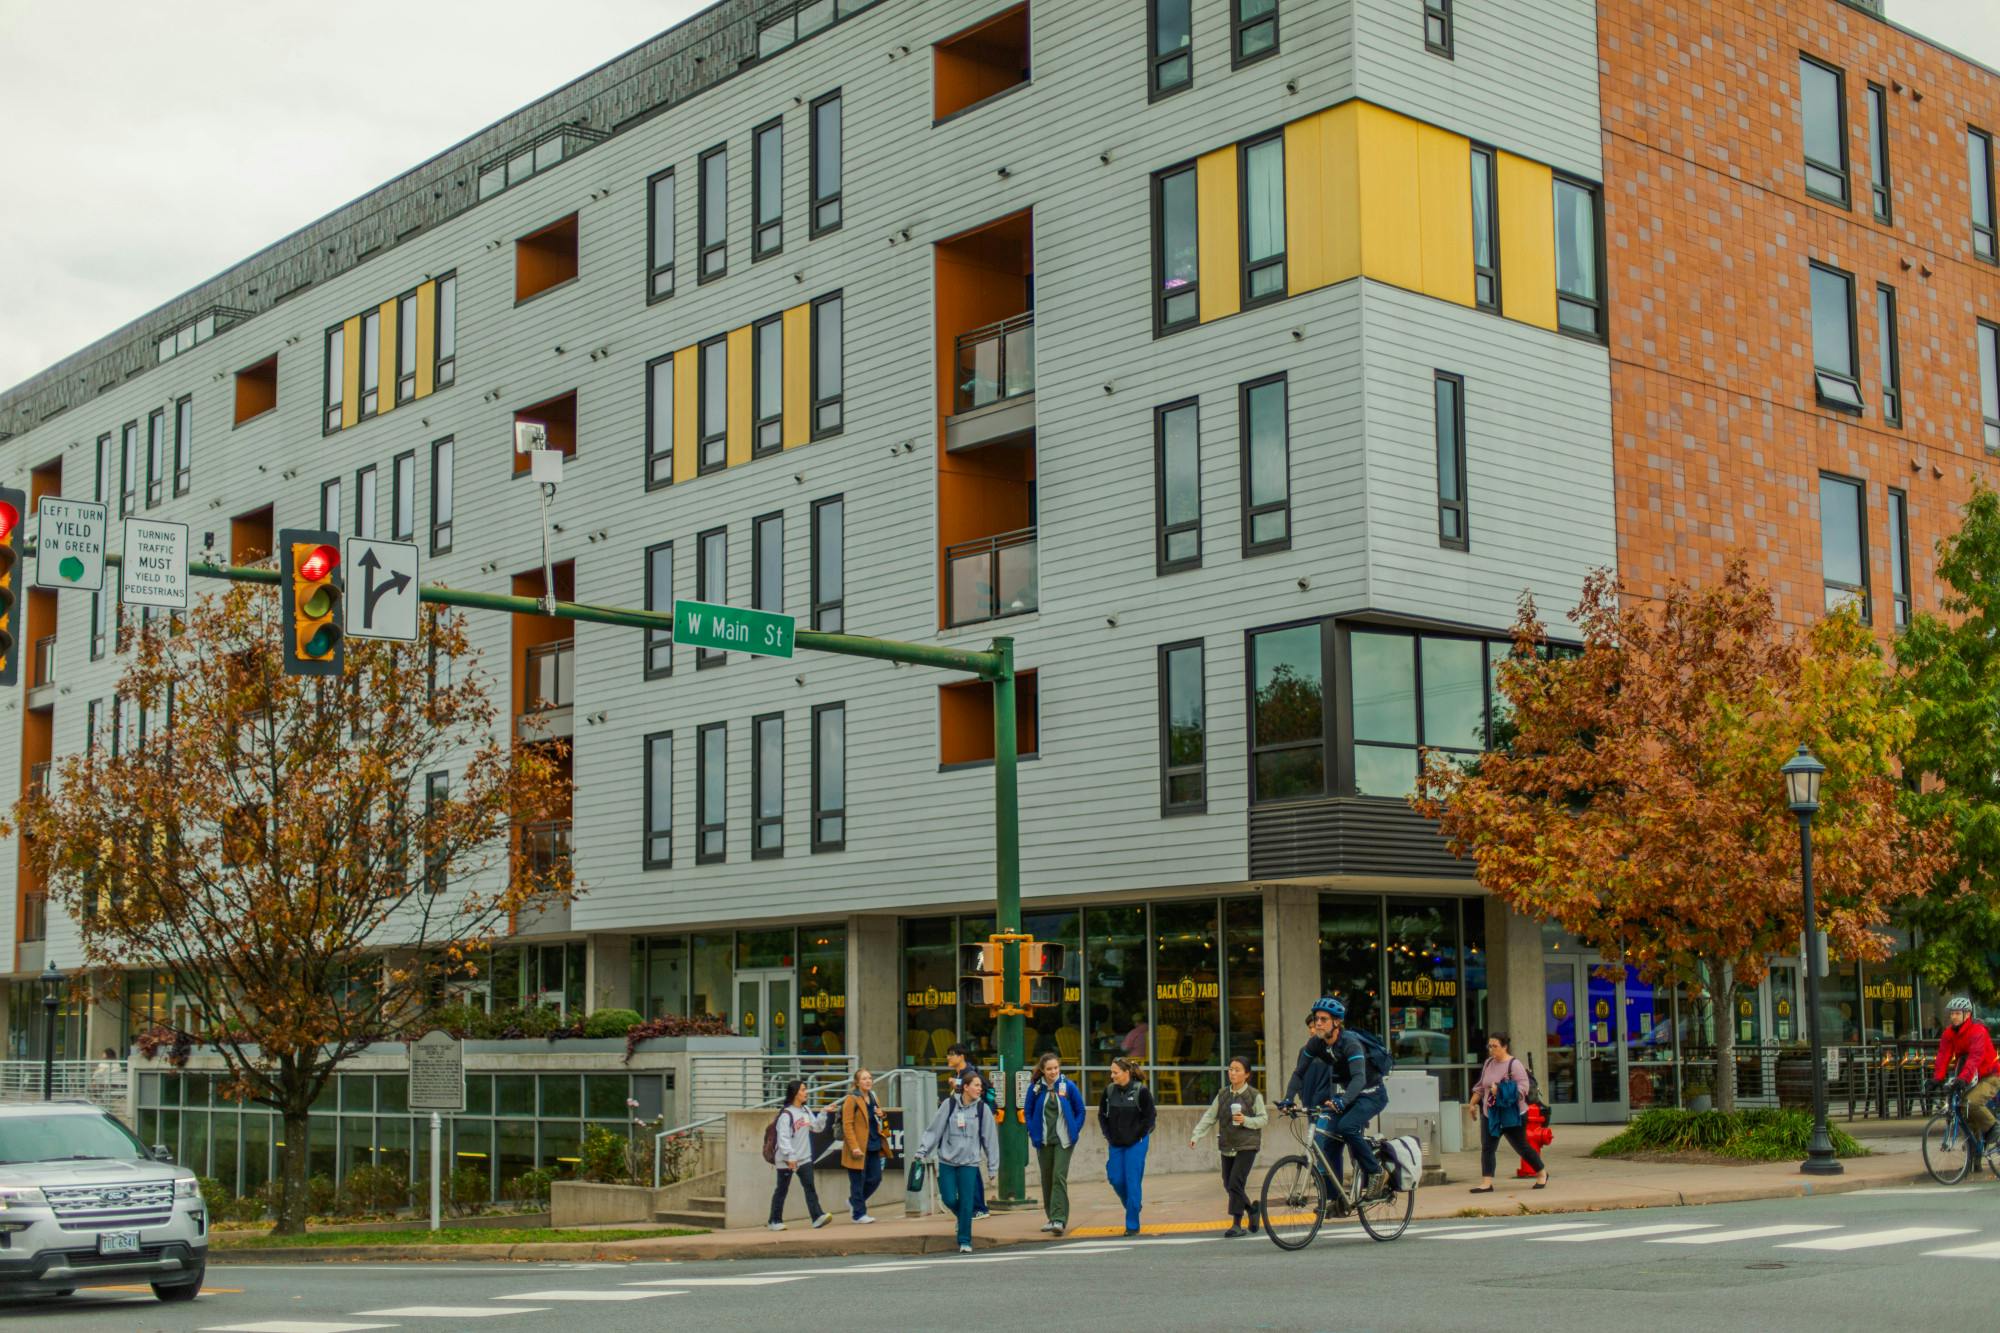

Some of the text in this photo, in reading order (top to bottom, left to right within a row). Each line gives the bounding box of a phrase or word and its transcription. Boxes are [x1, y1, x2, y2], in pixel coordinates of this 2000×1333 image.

[43, 504, 103, 521] LEFT TURN
[55, 521, 91, 538] YIELD
[137, 529, 176, 541] TURNING
[44, 538, 99, 554] ON GREEN
[138, 542, 174, 554] TRAFFIC
[139, 556, 172, 570] MUST
[135, 572, 176, 584] YIELD TO
[124, 584, 185, 598] PEDESTRIANS
[687, 612, 783, 647] W Main St
[1157, 984, 1177, 1000] BACK
[1197, 983, 1218, 998] YARD
[1391, 980, 1414, 997] BACK
[1434, 981, 1456, 997] YARD
[1864, 985, 1882, 999] BACK
[1896, 985, 1913, 999] YARD
[800, 996, 816, 1009] BACK
[829, 995, 845, 1008] YARD
[906, 992, 924, 1006] BACK
[938, 991, 957, 1005] YARD
